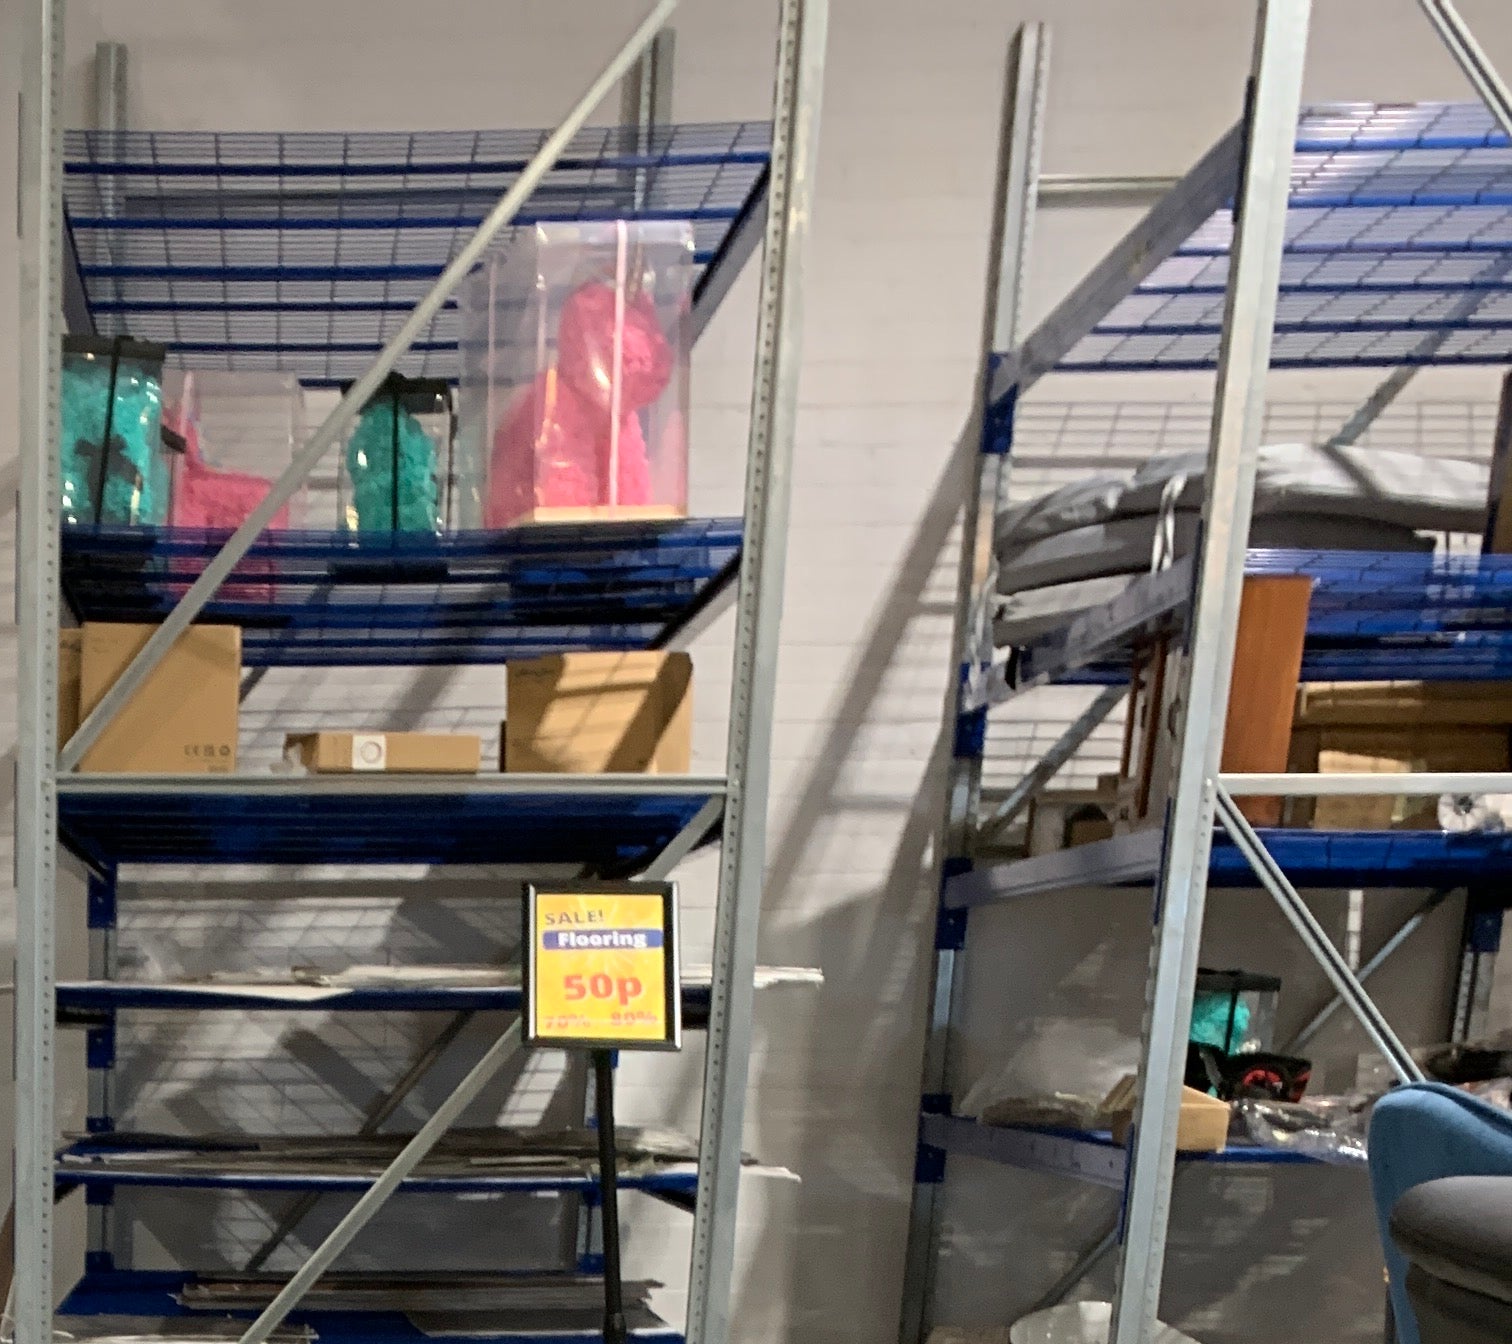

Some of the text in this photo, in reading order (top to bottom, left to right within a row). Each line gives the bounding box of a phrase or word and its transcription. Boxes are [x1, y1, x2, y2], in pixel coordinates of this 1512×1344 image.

[544, 909, 604, 926] SALE!
[557, 930, 648, 949] Flooring
[563, 973, 643, 1006] 50p
